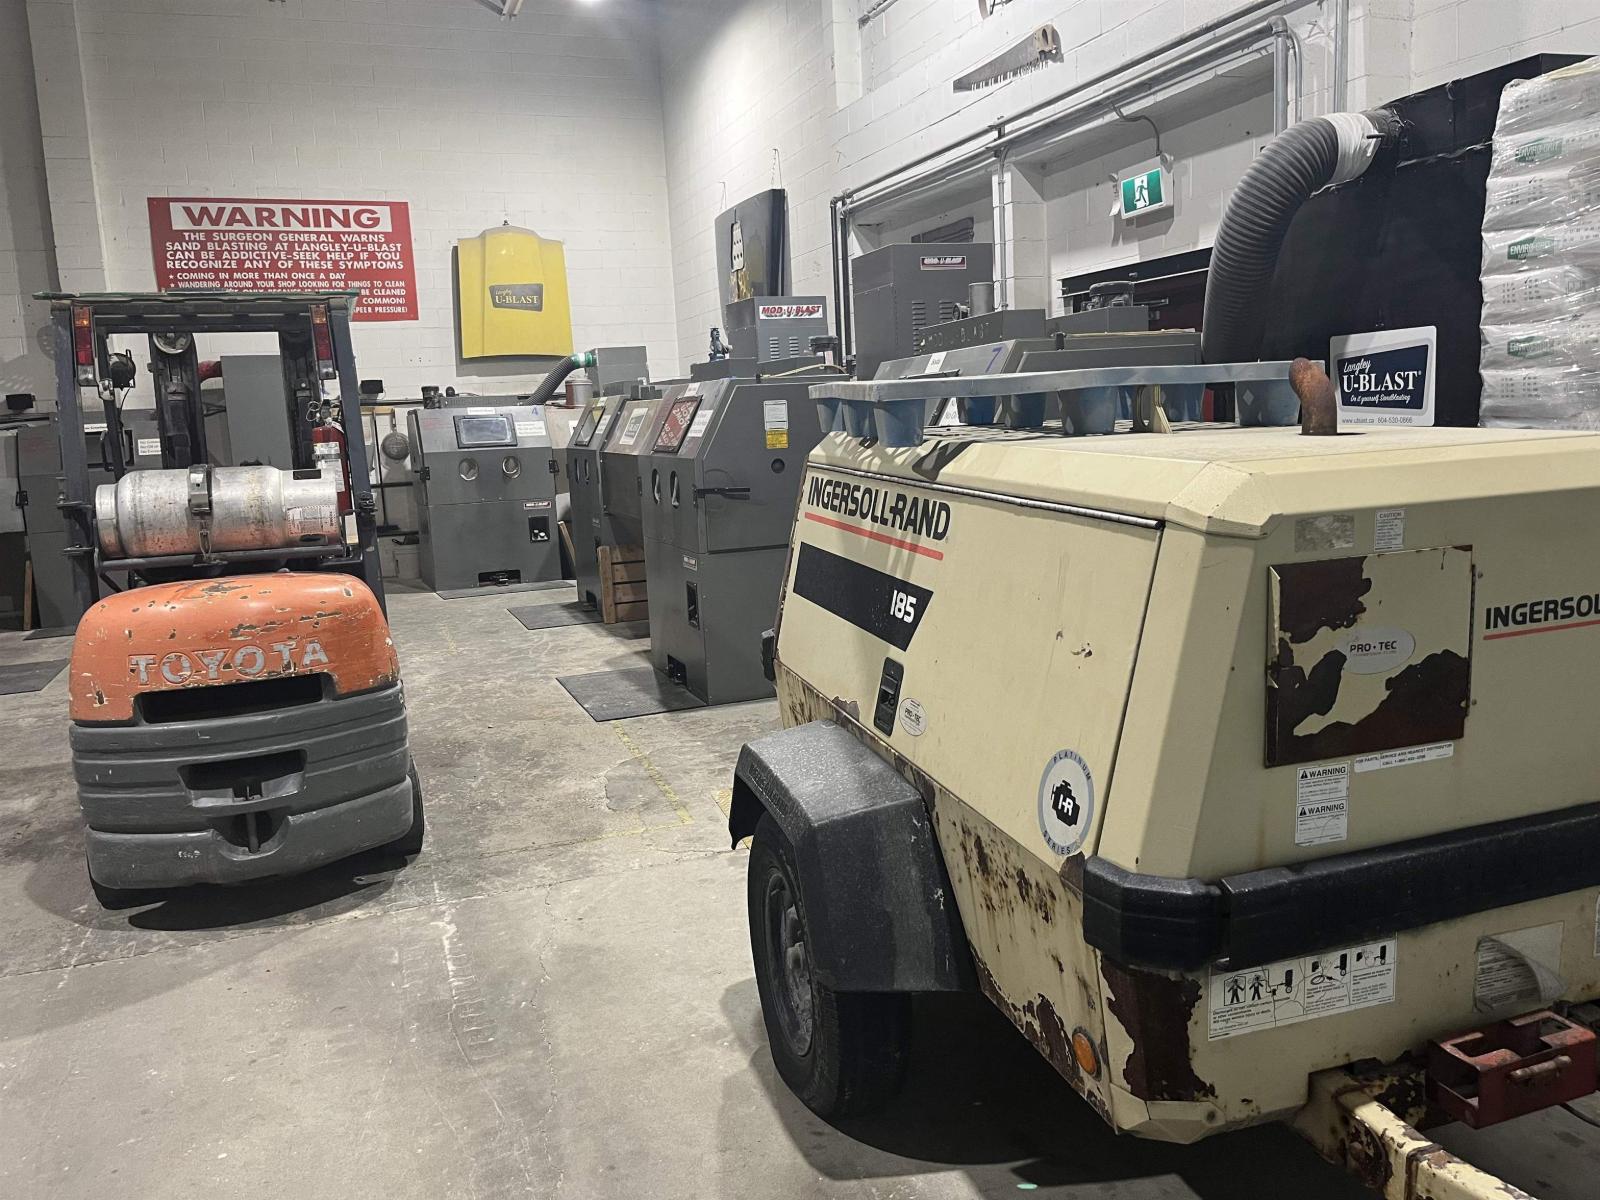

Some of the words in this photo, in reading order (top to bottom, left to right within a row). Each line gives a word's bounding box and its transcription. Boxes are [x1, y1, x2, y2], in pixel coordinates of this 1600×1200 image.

[182, 206, 380, 229] WARNING
[183, 232, 206, 241] THE
[212, 232, 272, 241] SURGEON
[279, 233, 334, 242] GENERAL
[340, 234, 385, 242] WARNS
[166, 242, 201, 251] SAND
[207, 242, 267, 251] BLASTING
[275, 243, 288, 251] AT
[295, 243, 402, 252] LANGLEY-U-BLAST
[166, 251, 195, 260] CAN
[201, 251, 215, 260] BE
[222, 251, 320, 260] ADDICTIVE-SEEK
[326, 252, 354, 260] HELP
[360, 252, 369, 260] IF
[375, 252, 400, 260] YOU
[166, 260, 238, 269] RECOGNIZE
[244, 260, 271, 269] ANY
[277, 261, 294, 269] OF
[300, 261, 334, 269] THESE
[339, 261, 404, 270] SYMPTOMS
[176, 272, 215, 280] COMING
[219, 272, 229, 280] IN
[233, 272, 259, 280] MORE
[263, 272, 288, 280] THAN
[291, 272, 316, 280] ONCE
[319, 272, 326, 280] A
[329, 272, 346, 280] DAY
[224, 280, 253, 288] AROUND
[256, 280, 275, 288] YOUR
[278, 280, 296, 288] SHOP
[299, 280, 329, 288] LOOKING
[332, 280, 346, 288] FOR
[347, 280, 371, 288] THINGS
[373, 280, 382, 288] TO
[384, 280, 405, 288] CLEAN
[362, 297, 406, 305] COMMON)
[495, 295, 539, 304] U-BLAST
[985, 347, 1003, 373] 7
[1344, 358, 1371, 376] Langley
[1342, 371, 1418, 393] U-BLAST
[890, 589, 917, 624] 185
[129, 639, 329, 685] TOYOTA
[1053, 751, 1092, 780] PLATINUM
[1308, 766, 1346, 778] WARNING
[1307, 803, 1345, 814] WARNING
[1043, 830, 1071, 855] SERIES
